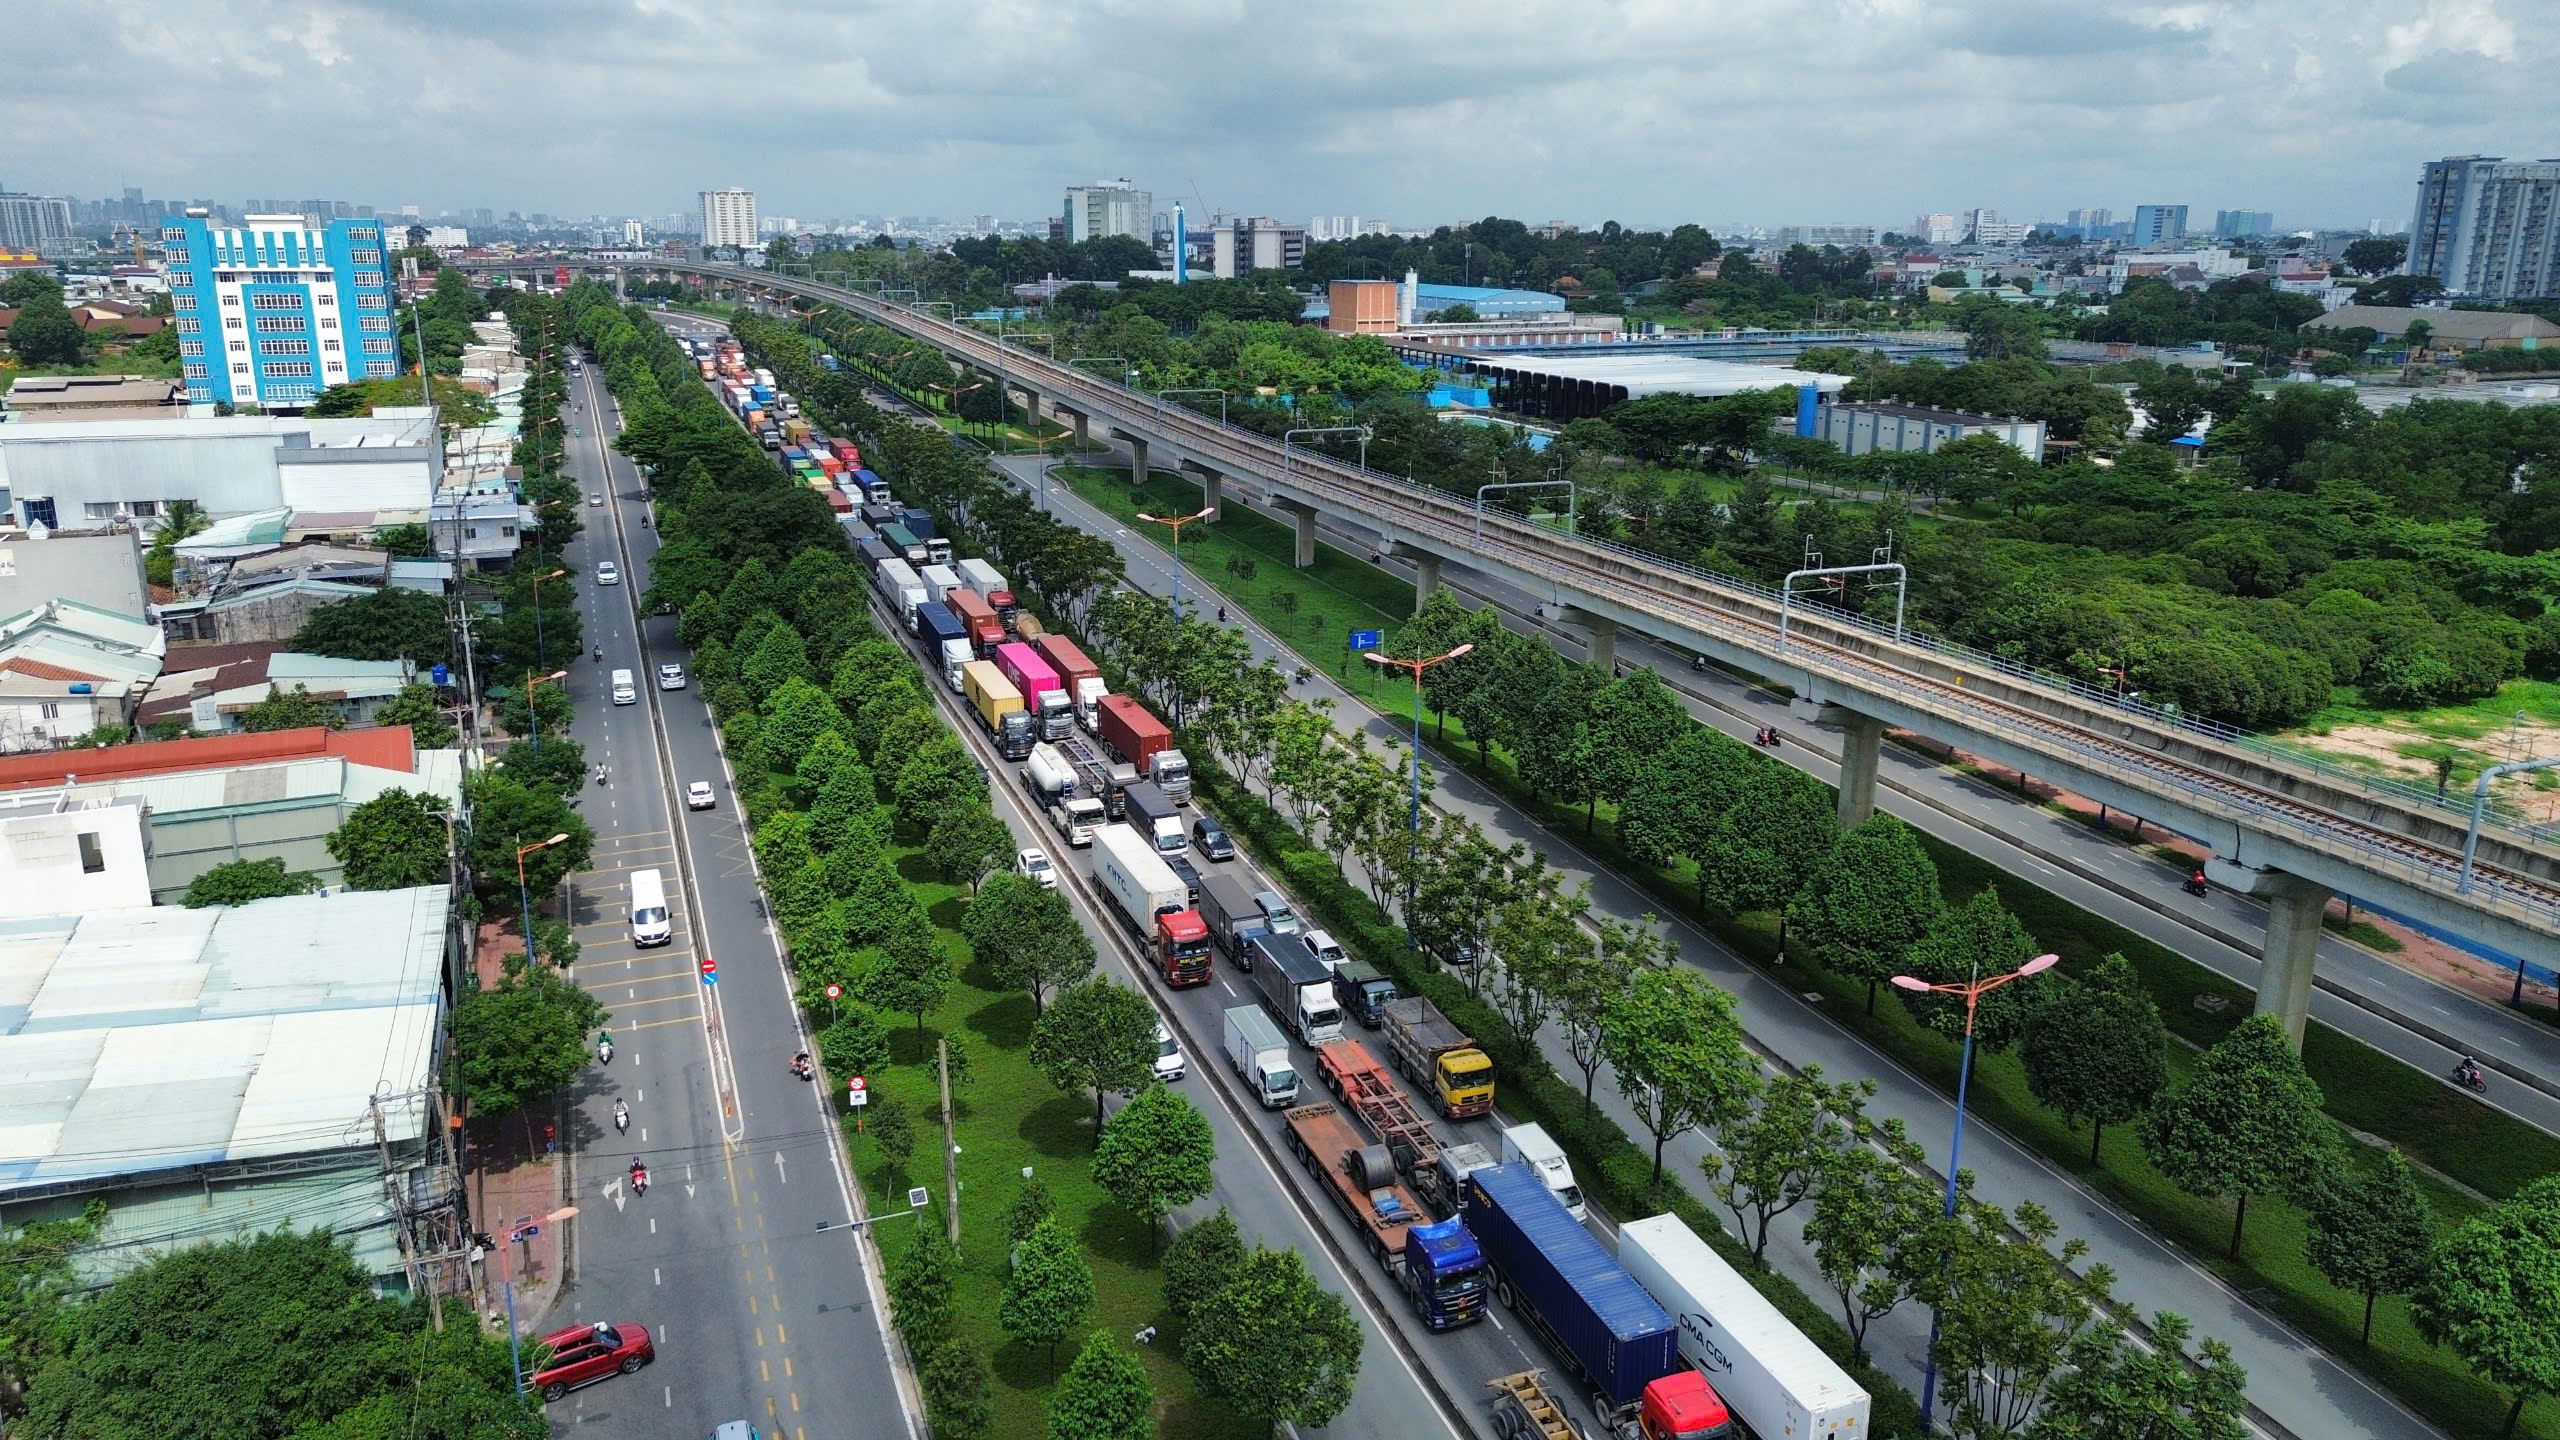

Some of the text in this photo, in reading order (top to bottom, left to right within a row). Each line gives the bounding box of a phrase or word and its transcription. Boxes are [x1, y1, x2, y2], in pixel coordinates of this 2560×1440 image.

[1106, 860, 1127, 892] KMTC
[1680, 1312, 1734, 1376] CMA CGM
